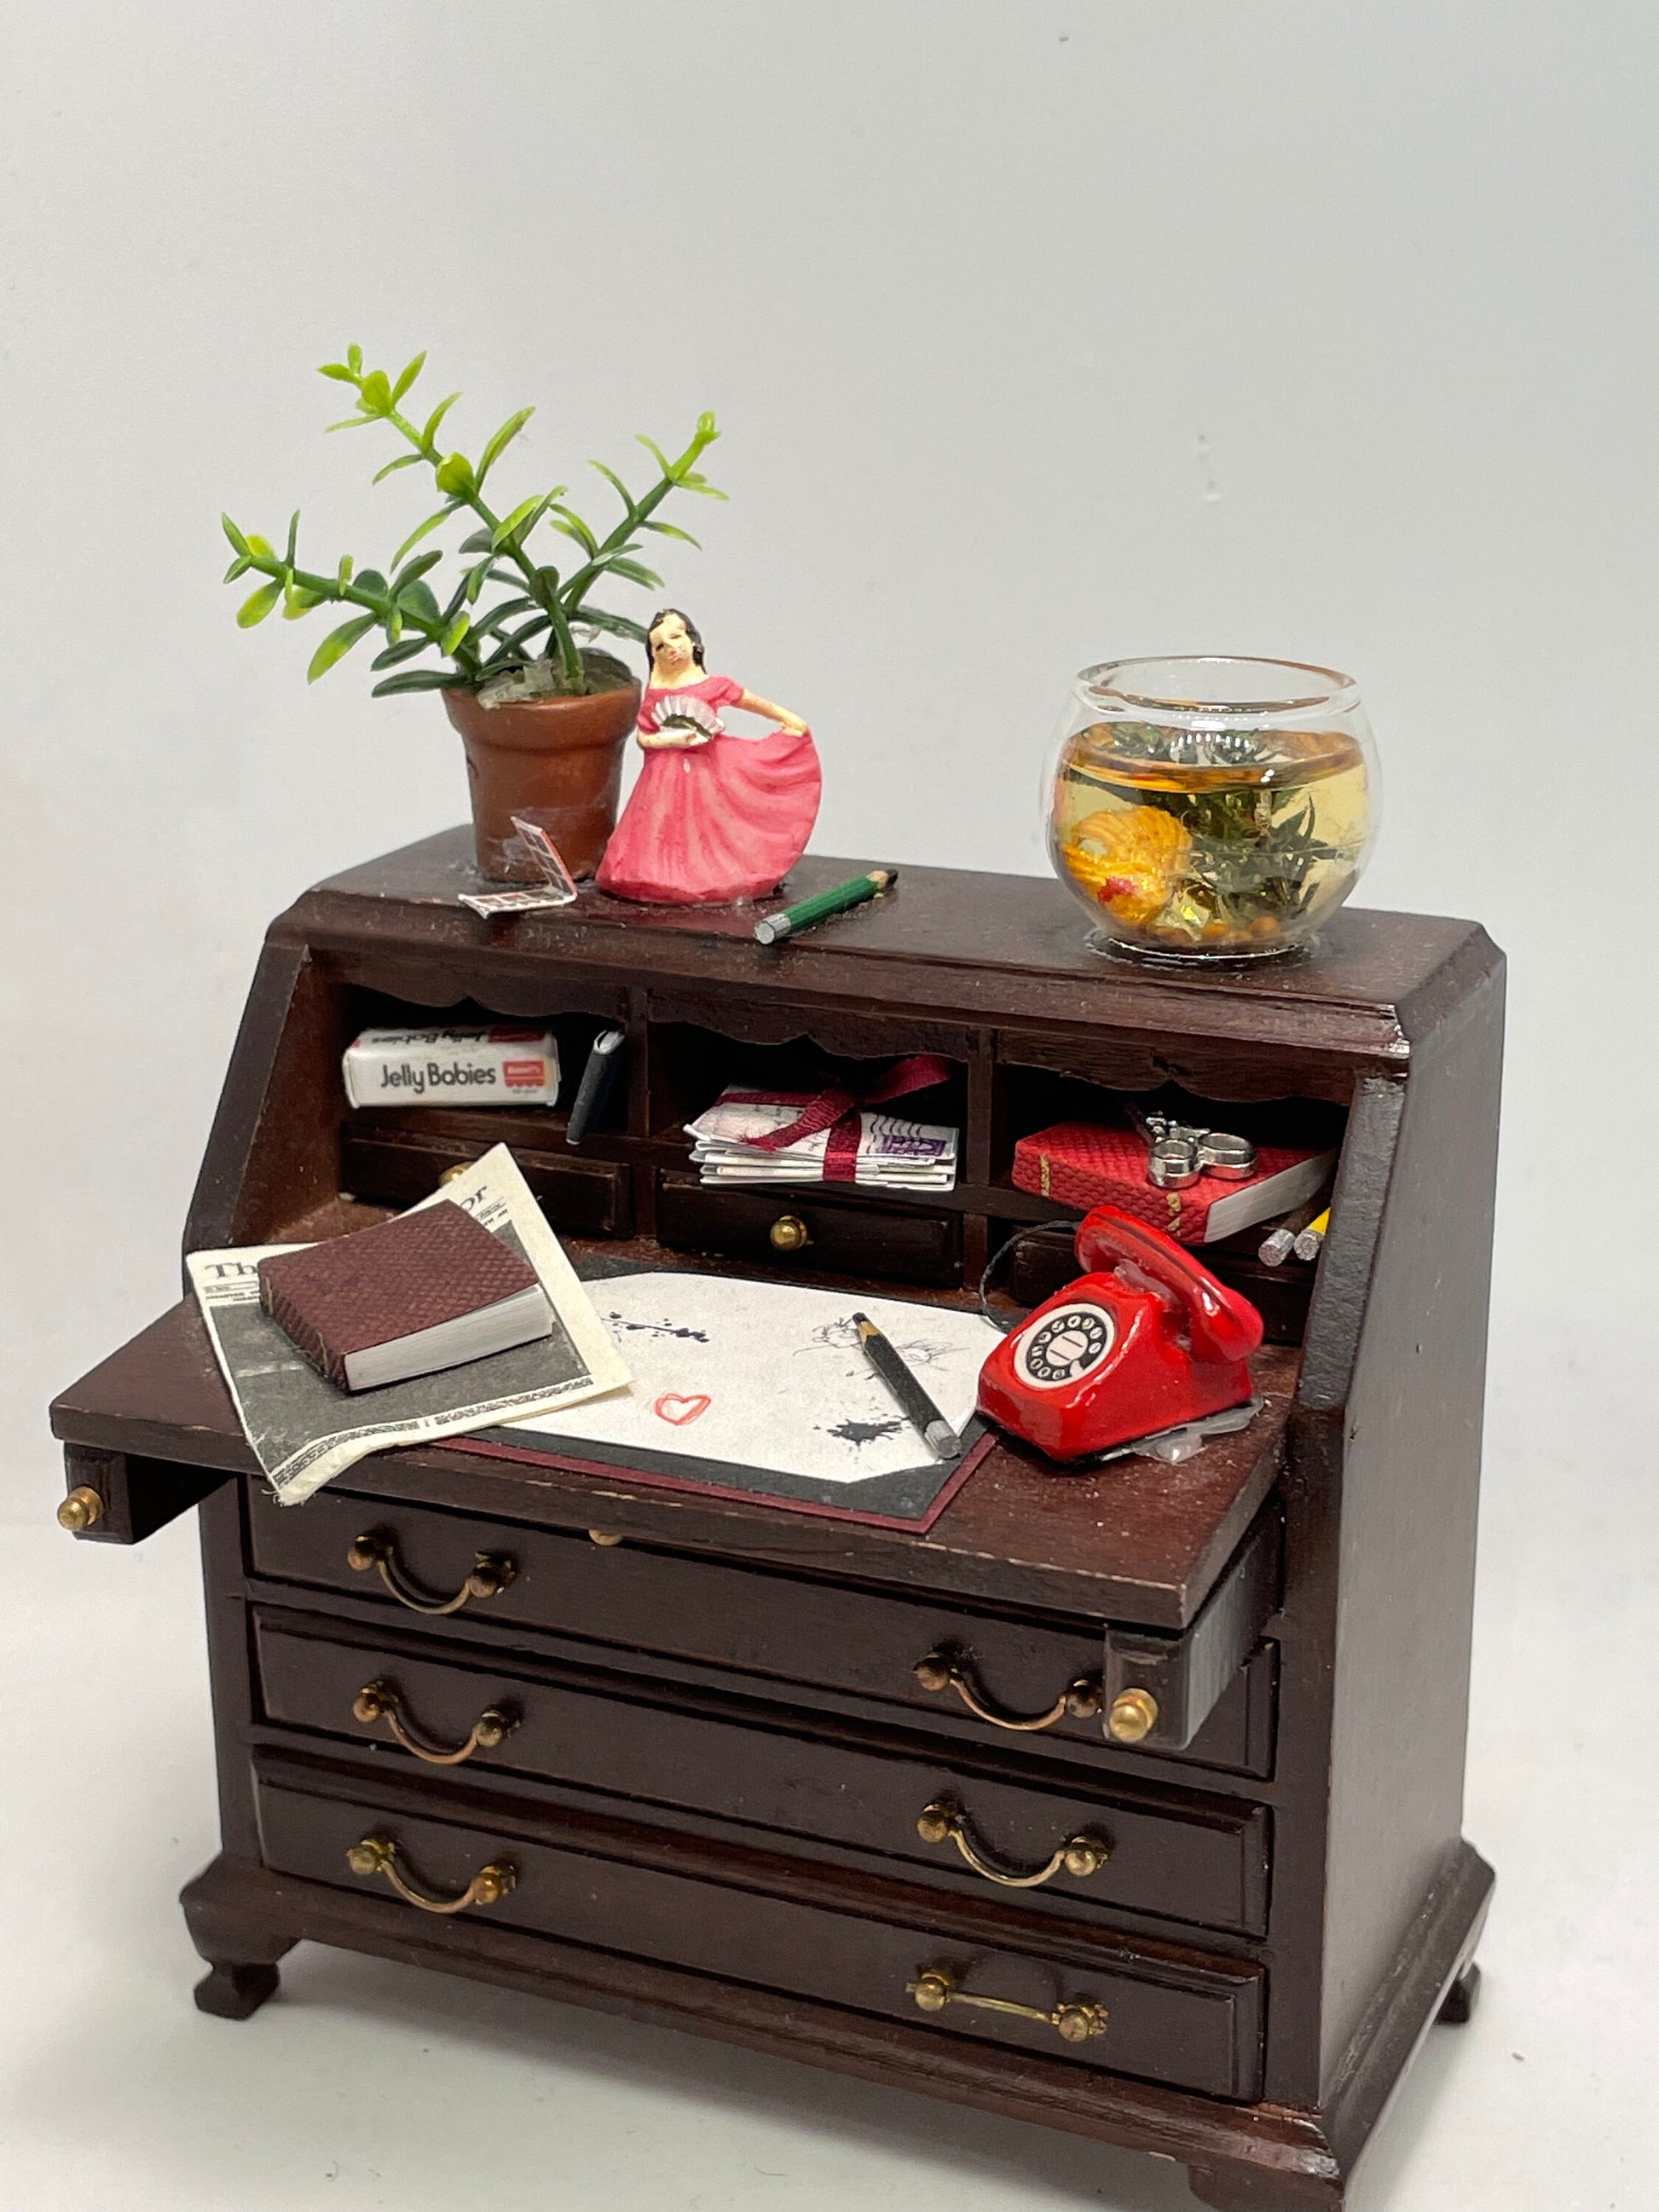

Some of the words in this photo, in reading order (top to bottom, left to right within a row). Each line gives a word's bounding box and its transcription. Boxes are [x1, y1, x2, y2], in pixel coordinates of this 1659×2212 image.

[381, 1063, 425, 1094] Jelly
[427, 1061, 496, 1087] Babies
[205, 1262, 258, 1279] Th
